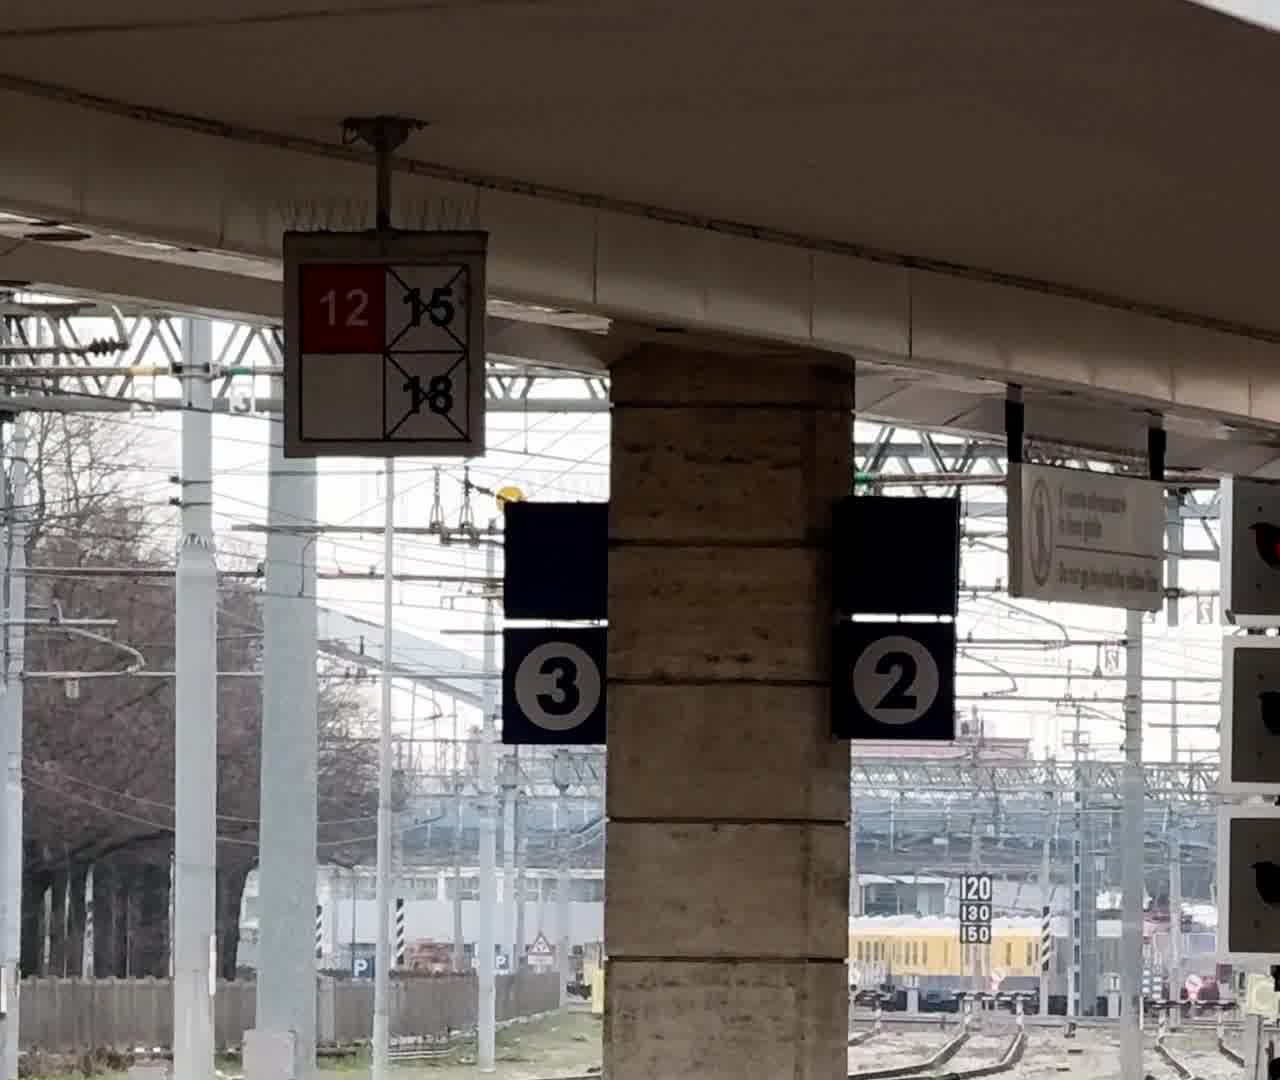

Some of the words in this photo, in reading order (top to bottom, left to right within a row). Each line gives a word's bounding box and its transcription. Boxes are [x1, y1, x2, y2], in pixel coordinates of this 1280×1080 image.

[319, 288, 370, 327] 12
[403, 287, 454, 327] 15
[403, 375, 453, 415] 18
[535, 655, 580, 717] 3
[874, 650, 919, 710] 2
[961, 876, 991, 900] 120
[961, 905, 990, 921] 130
[961, 926, 990, 942] 150
